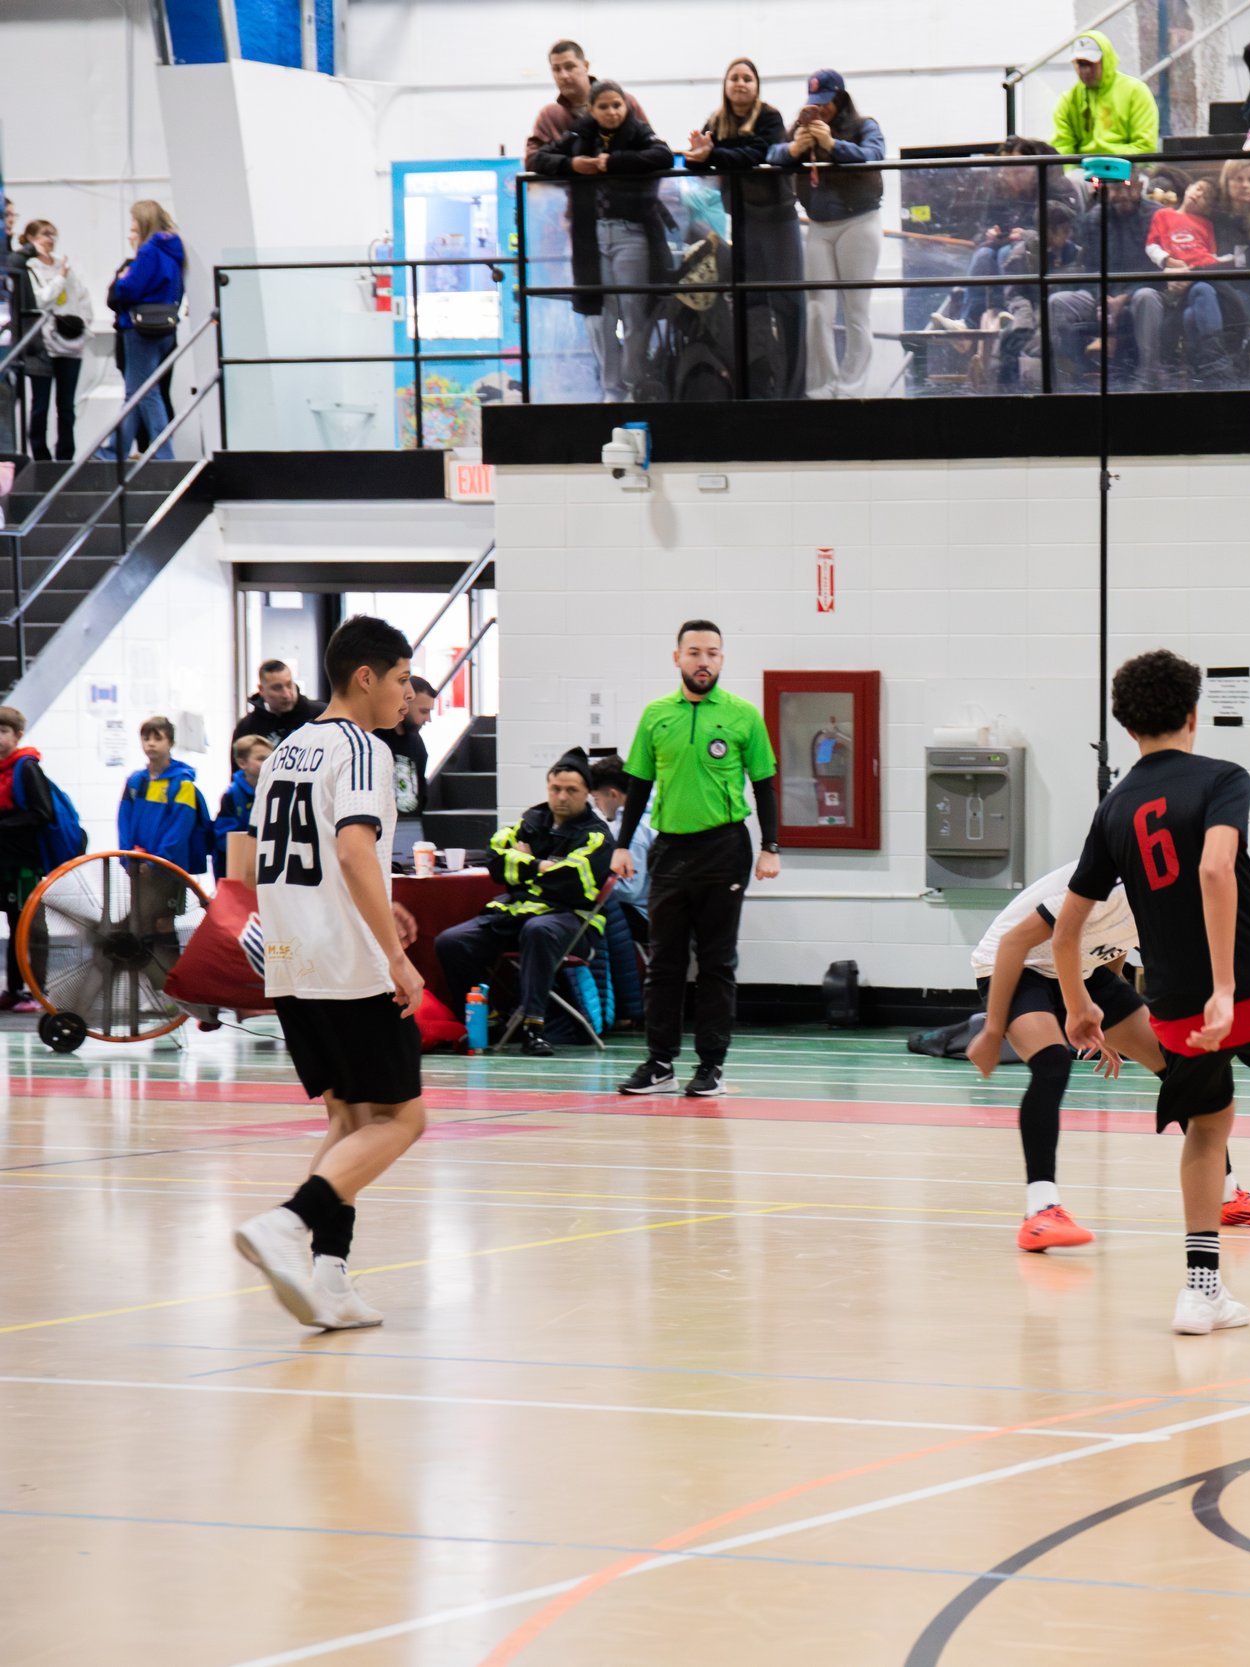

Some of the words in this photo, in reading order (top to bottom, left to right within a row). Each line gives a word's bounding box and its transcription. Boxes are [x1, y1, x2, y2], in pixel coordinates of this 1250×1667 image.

[457, 464, 492, 495] EXIT
[257, 780, 322, 886] 99
[1133, 796, 1179, 891] 6
